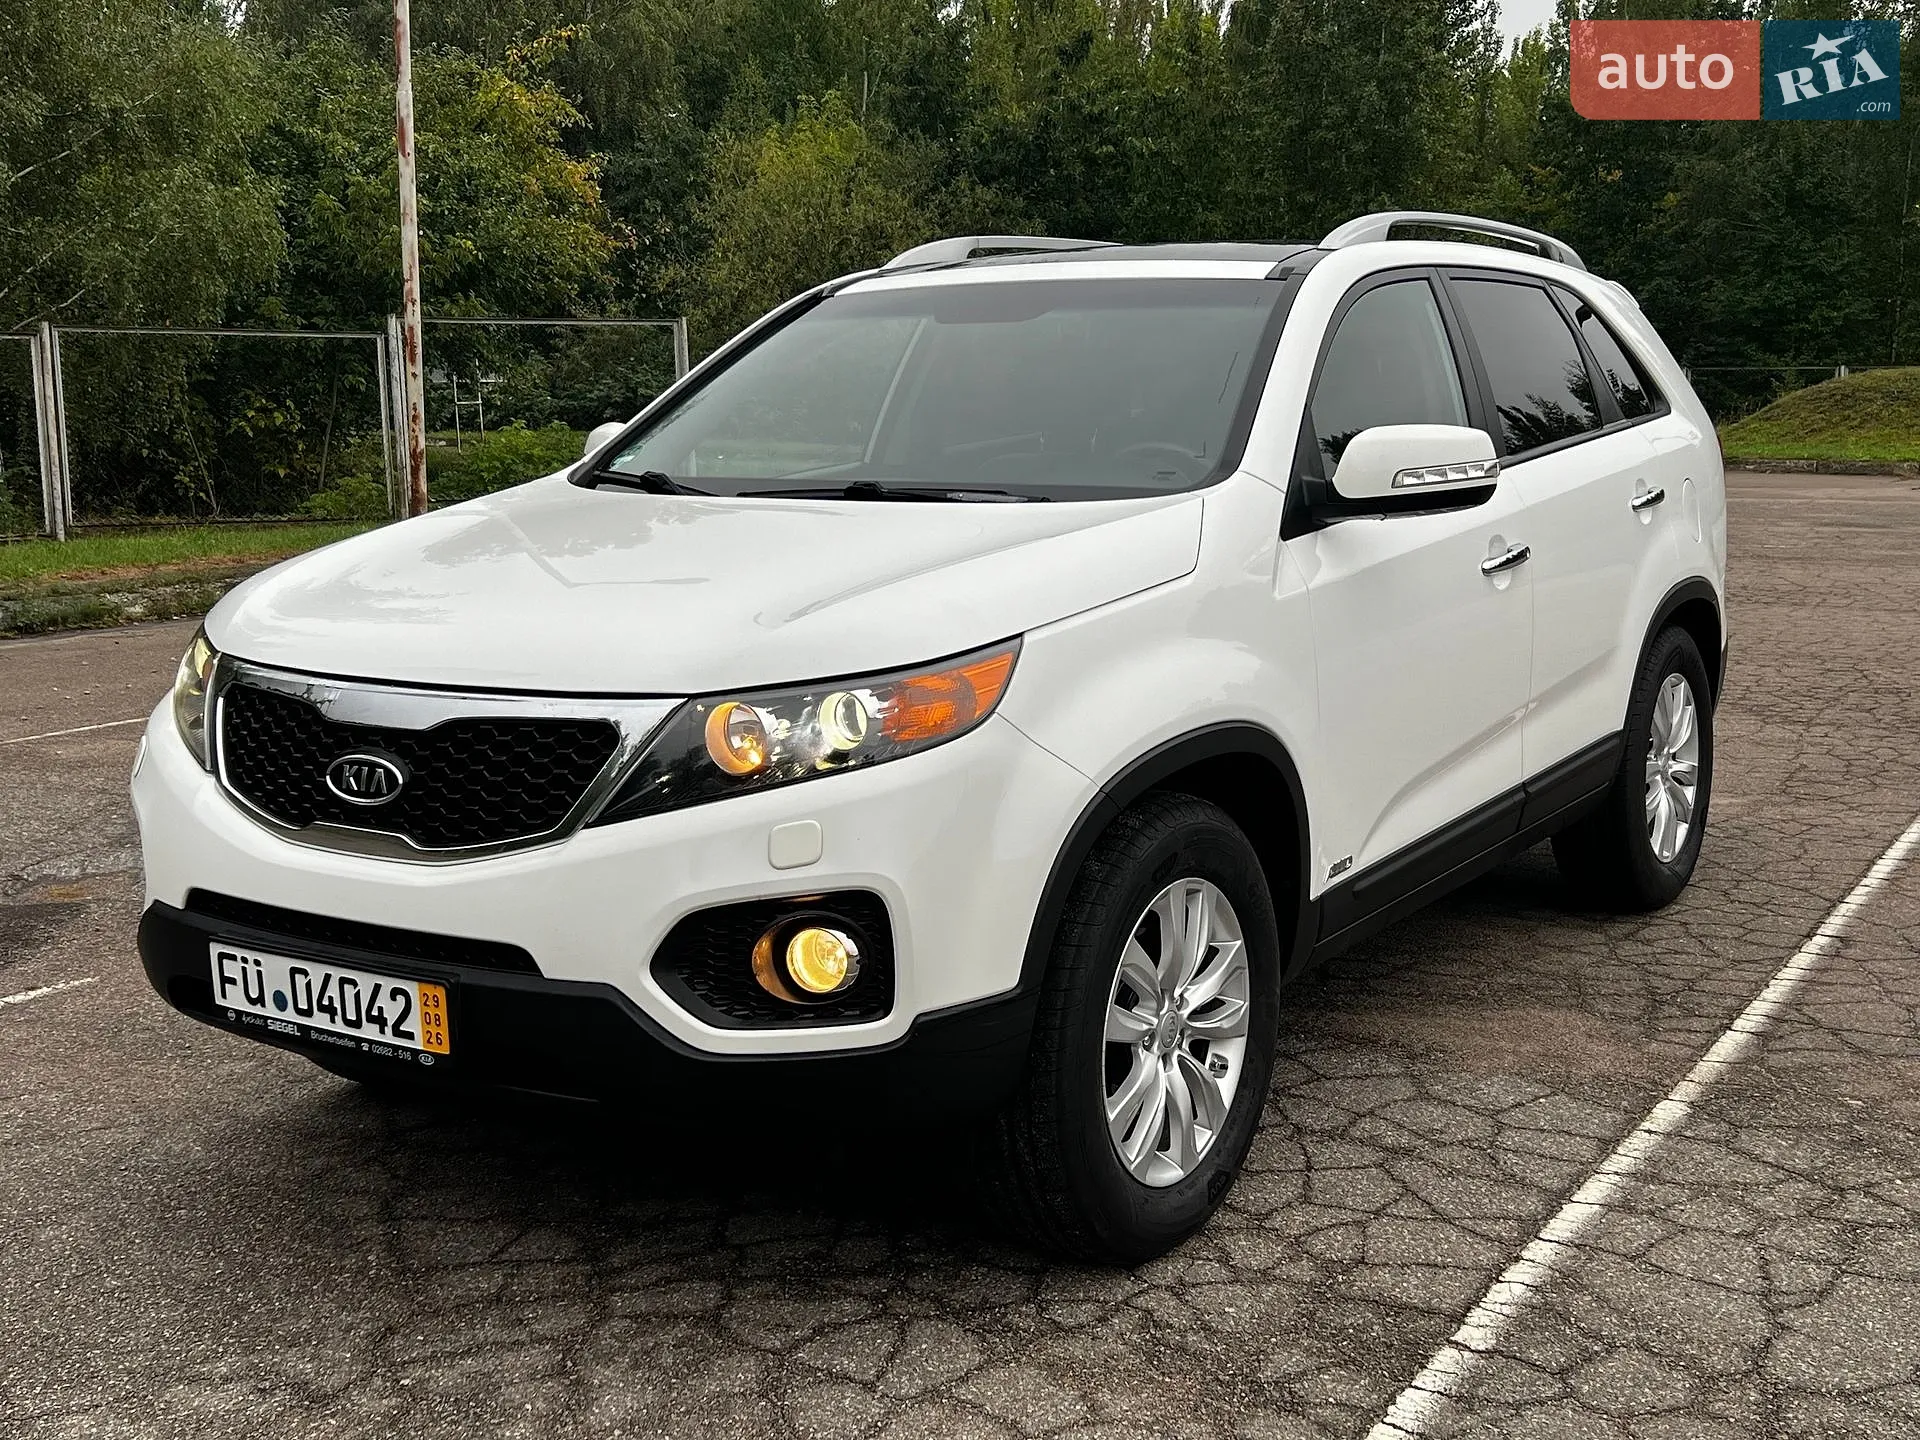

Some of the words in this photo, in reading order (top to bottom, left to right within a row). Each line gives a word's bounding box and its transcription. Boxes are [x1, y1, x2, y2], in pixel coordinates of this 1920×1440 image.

[342, 764, 388, 794] KIA
[217, 950, 267, 1009] FÜ
[289, 966, 416, 1042] 04042
[422, 992, 440, 1009] 29
[267, 1019, 301, 1036] SIEGEL
[424, 1011, 442, 1027] 08
[425, 1030, 444, 1046] 26
